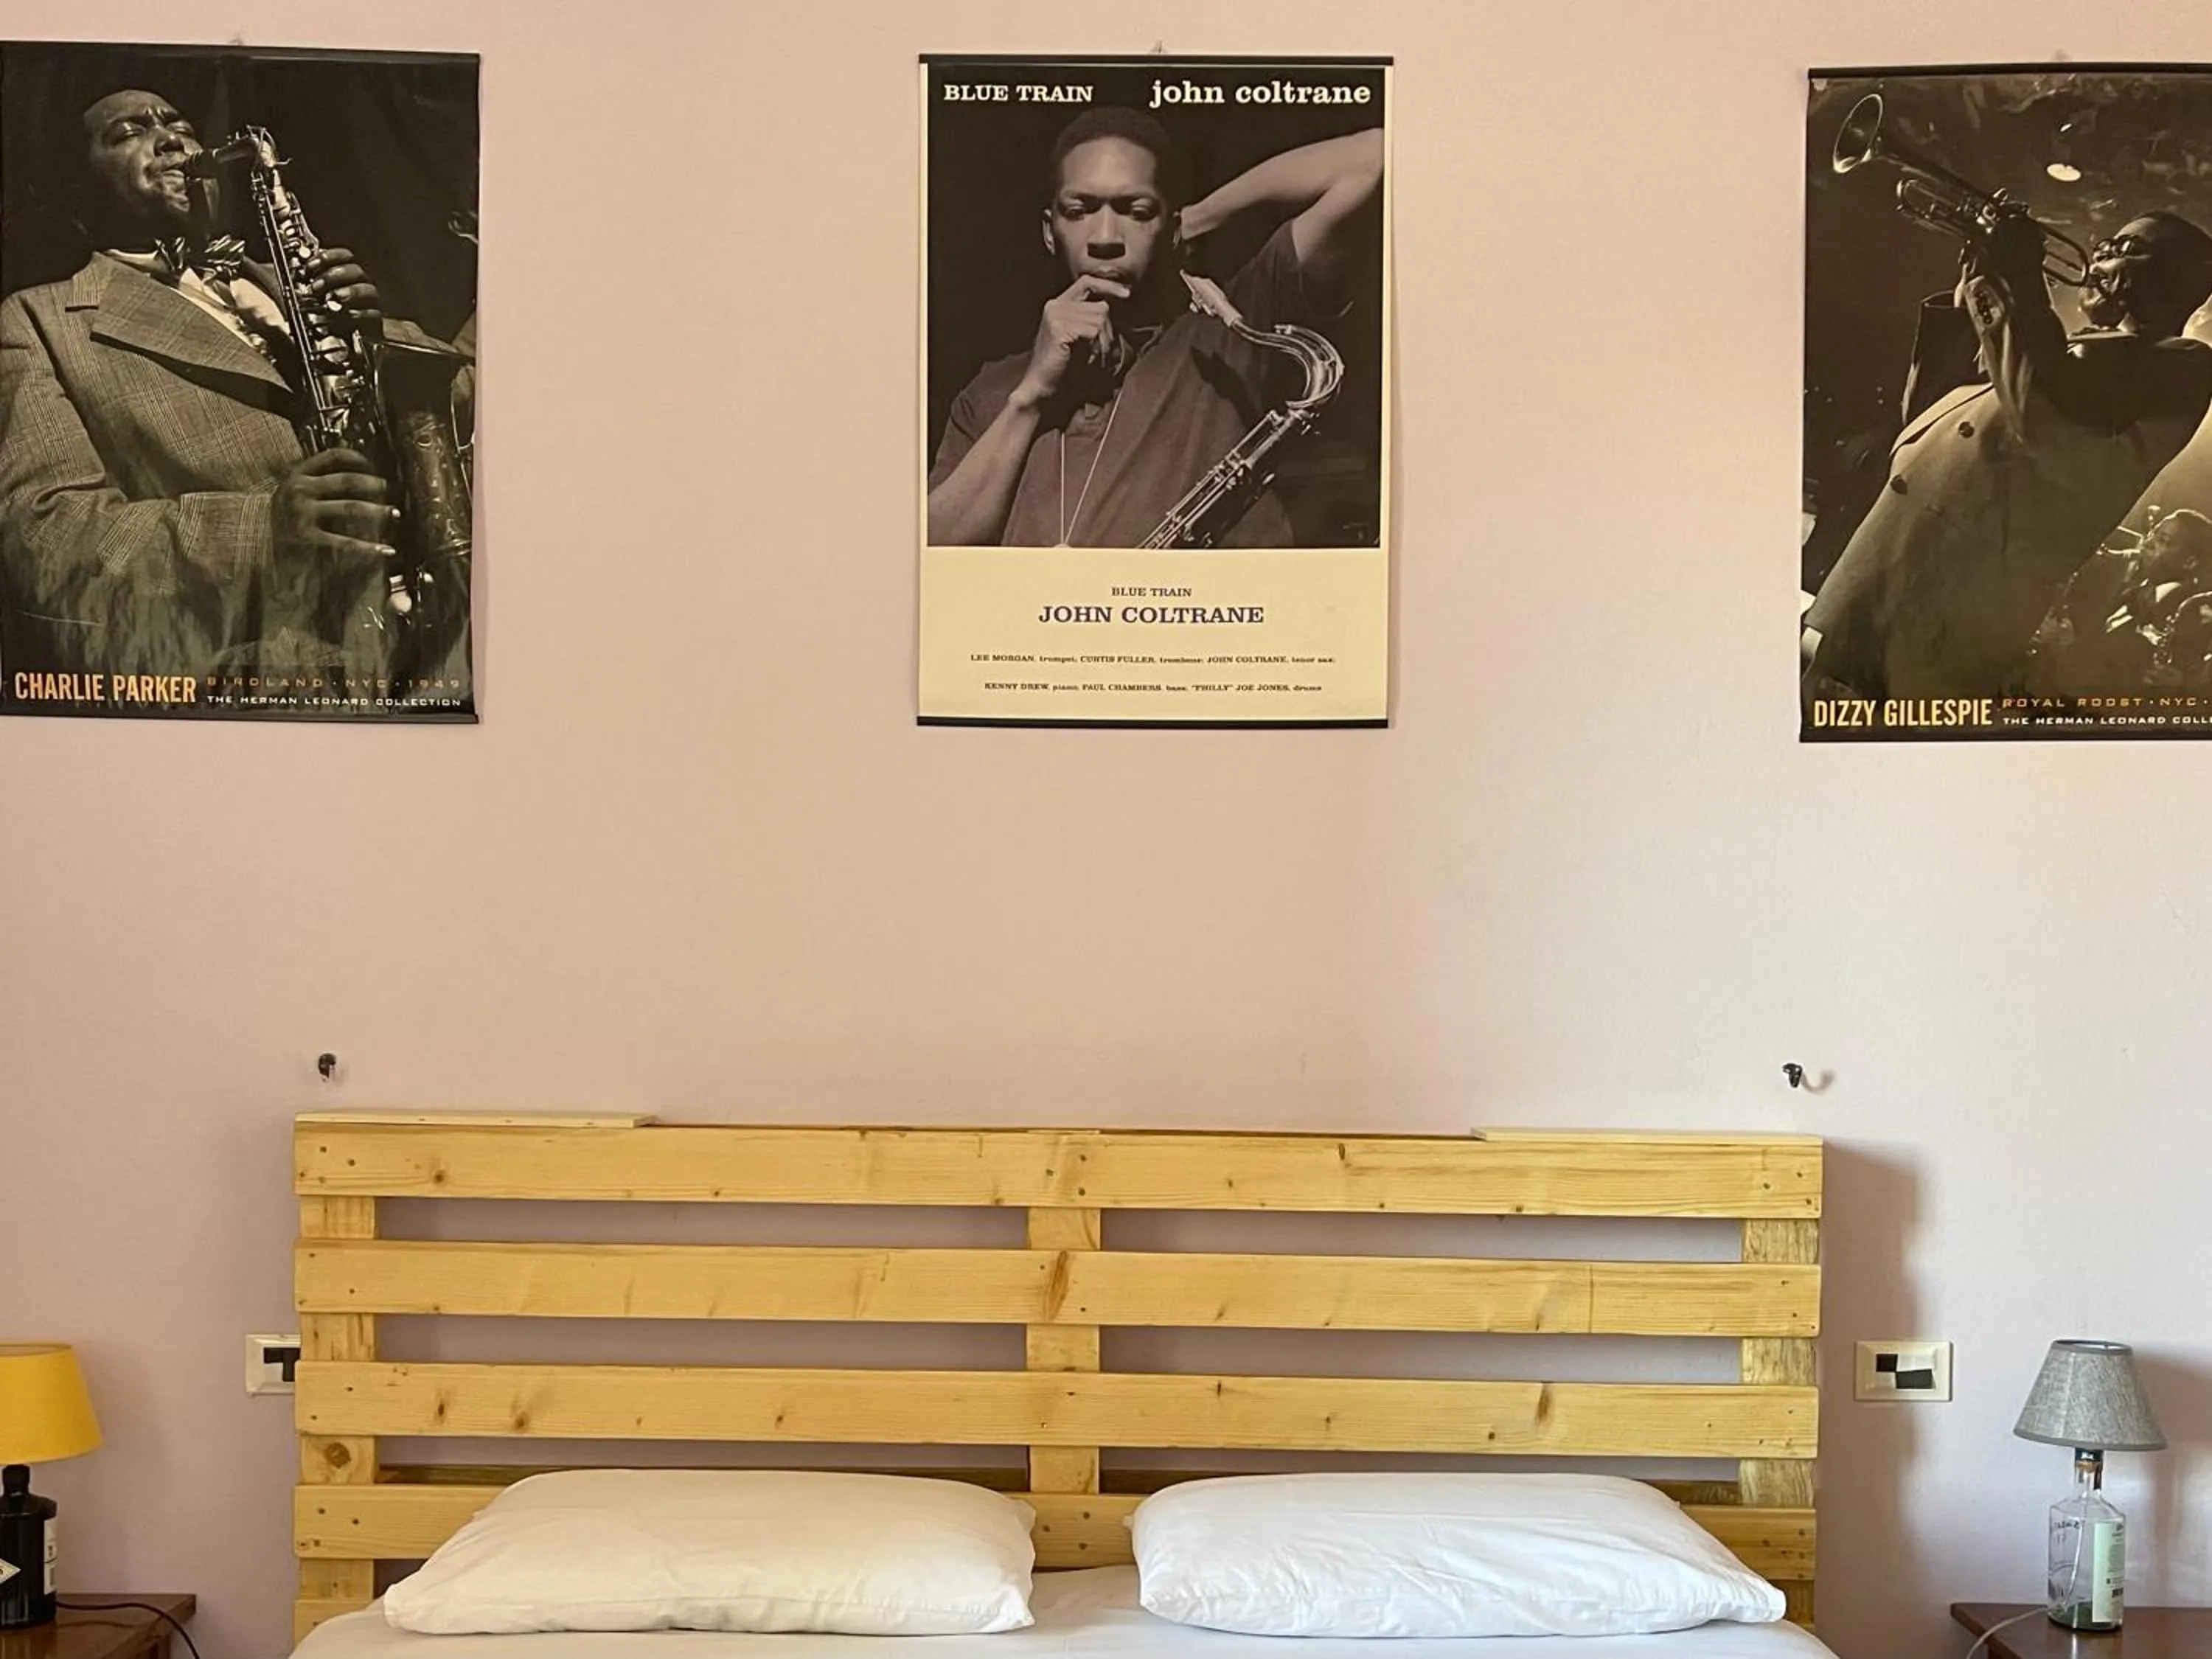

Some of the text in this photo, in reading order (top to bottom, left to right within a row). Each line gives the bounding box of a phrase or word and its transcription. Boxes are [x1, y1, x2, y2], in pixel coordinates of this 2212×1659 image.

[943, 85, 1093, 102] BLUE TRAIN
[1149, 80, 1371, 109] john coltrane
[1111, 587, 1192, 597] BLUE TRAIN
[1038, 605, 1265, 624] JOHN COLTRANE
[970, 654, 990, 662] LEE
[1206, 655, 1234, 664] JOHN
[14, 672, 197, 703] CHARLIE PARKER
[206, 676, 324, 688] BIRDLAND
[206, 695, 462, 706] THE HERMAN LEONARD COLLECTION
[2001, 697, 2197, 709] ROYAL ROOST NYC
[1814, 698, 1993, 727] DIZZY GILLESPIE
[2002, 717, 2029, 726] THE
[2035, 717, 2094, 726] HERMAN
[2100, 716, 2166, 725] LEONARD
